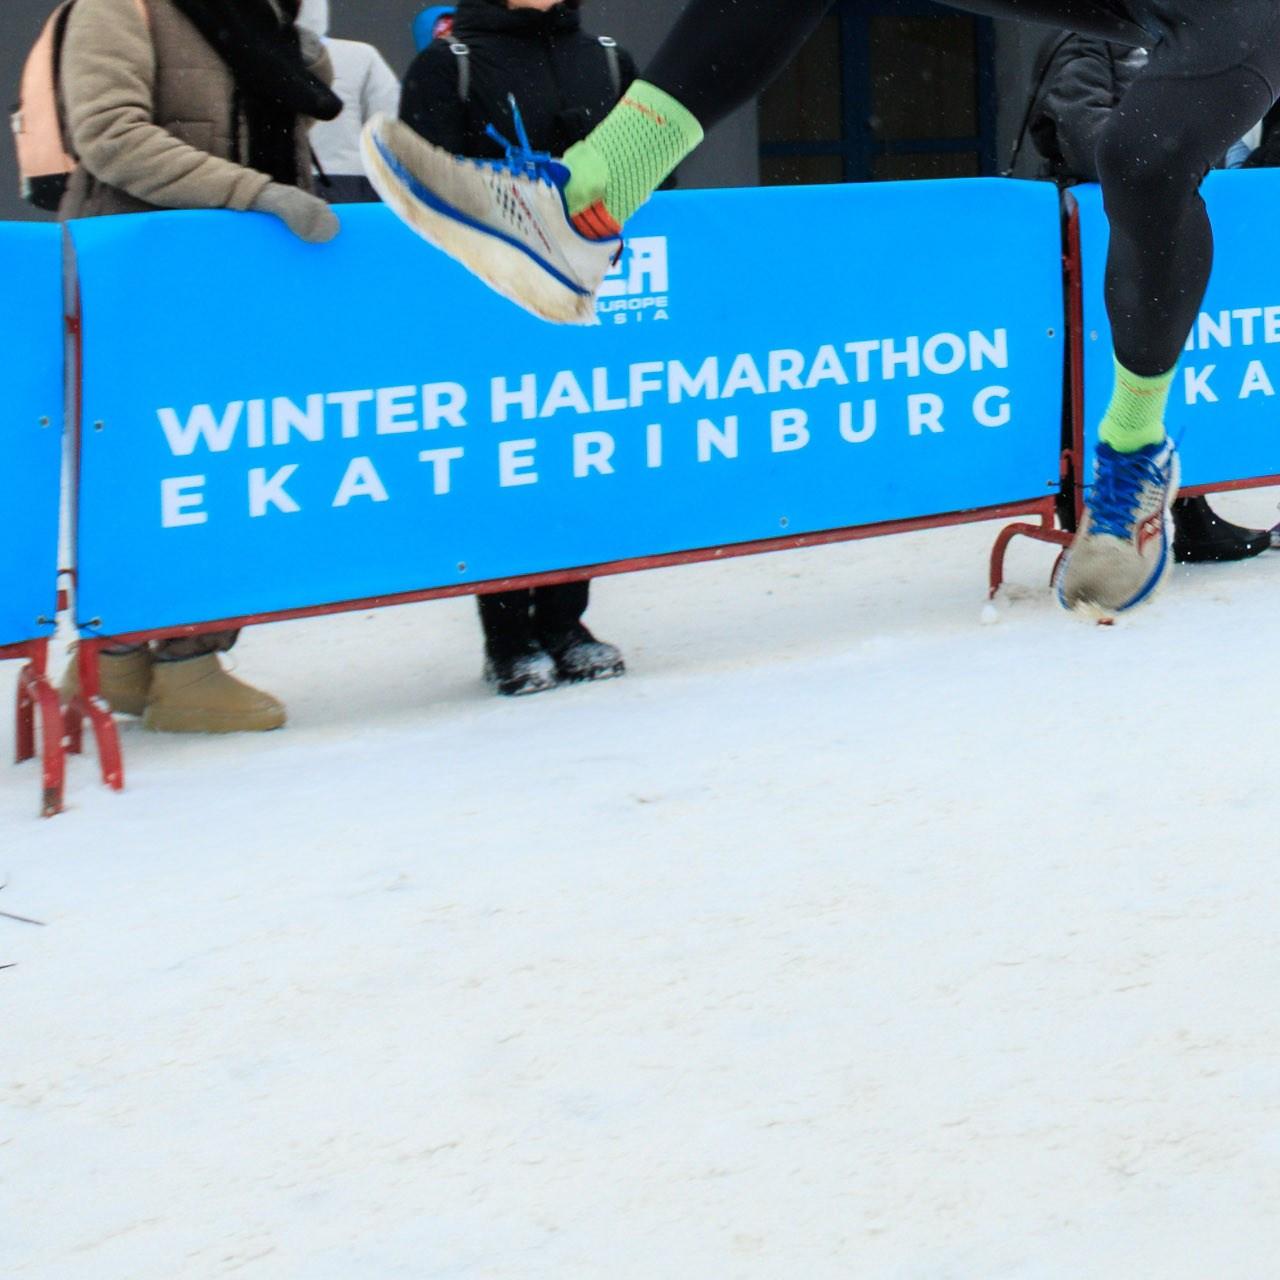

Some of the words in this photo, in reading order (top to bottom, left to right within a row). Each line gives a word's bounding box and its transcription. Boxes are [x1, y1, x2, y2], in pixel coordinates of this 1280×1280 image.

[156, 381, 467, 456] WINTER
[491, 328, 1008, 423] HALFMARATHON
[160, 385, 1012, 528] EKATERINBURG
